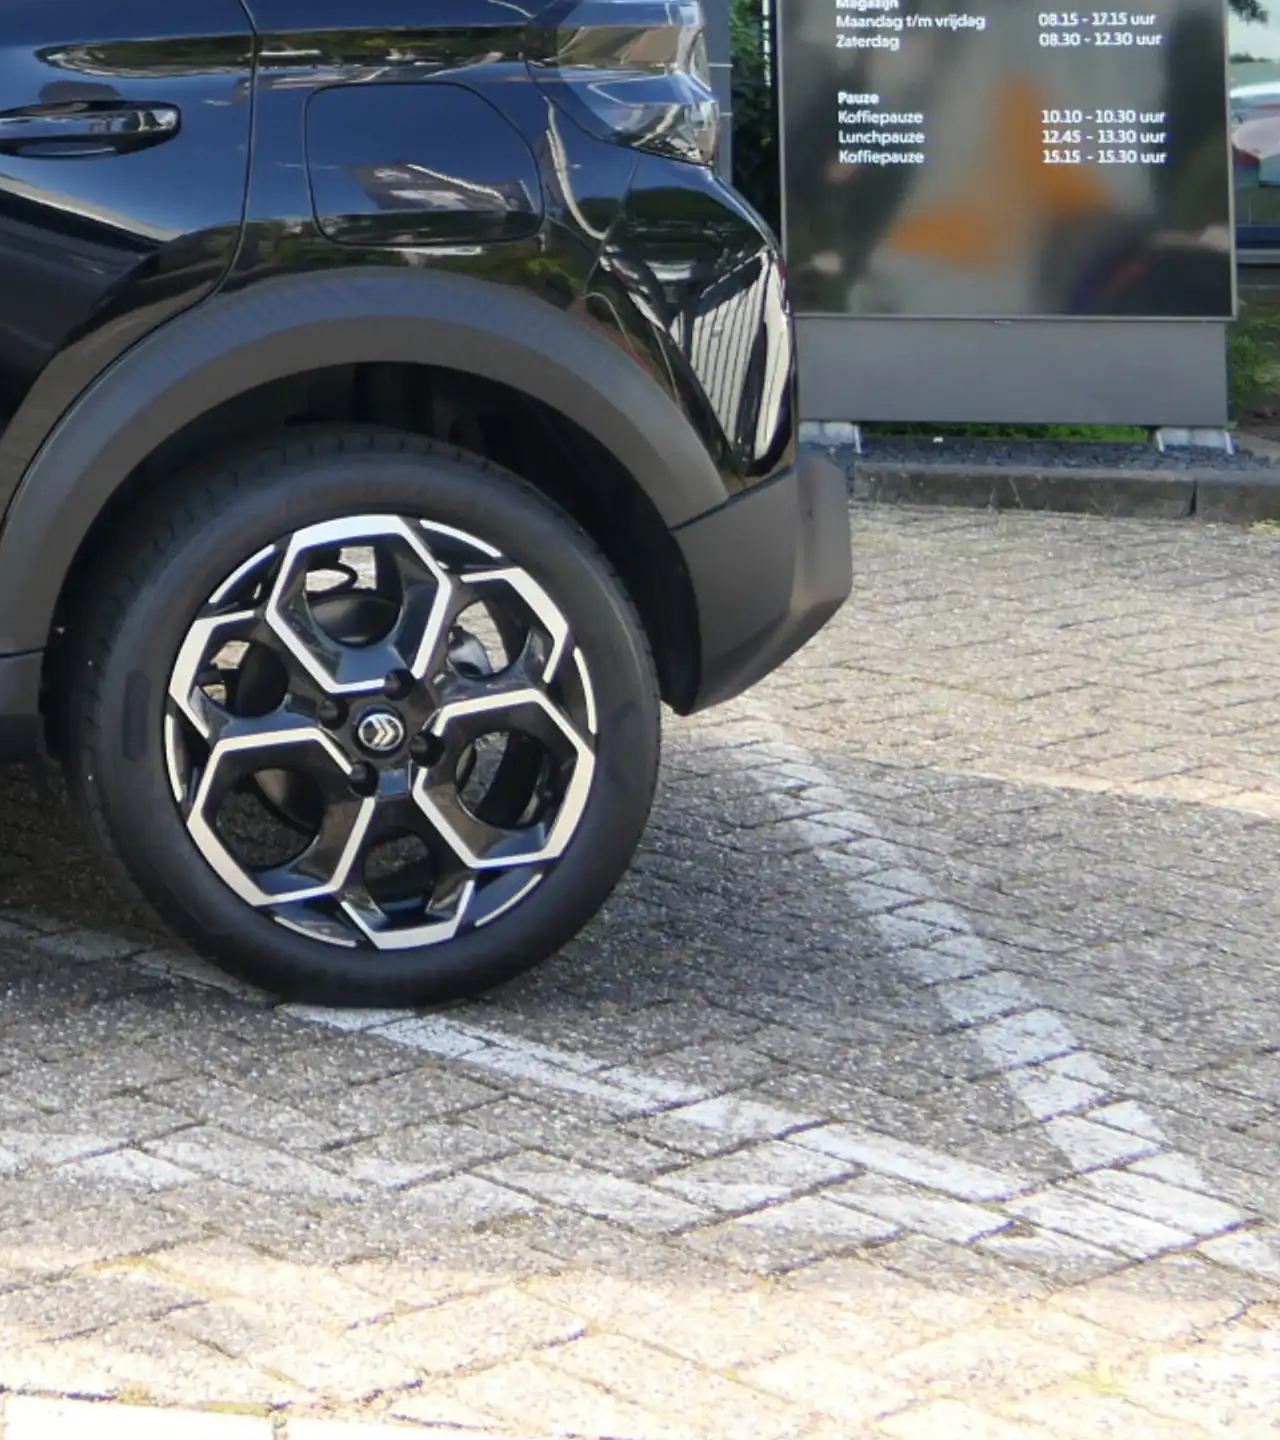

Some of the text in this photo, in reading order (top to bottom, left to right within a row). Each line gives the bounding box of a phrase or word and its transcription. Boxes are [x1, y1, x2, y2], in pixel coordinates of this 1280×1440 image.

[835, 15, 903, 31] Maandag
[905, 14, 932, 28] t/m
[935, 13, 986, 31] vrijdag
[1130, 13, 1156, 25] uur
[836, 34, 900, 51] Zaterdag
[1136, 34, 1162, 46] uur
[837, 91, 880, 104] Pauze
[838, 110, 924, 127] Koffiepauze
[1041, 109, 1083, 124] 10.10
[1095, 109, 1137, 124] 10.30
[1139, 111, 1166, 124] uur
[838, 130, 925, 147] Lunchpauze
[1042, 129, 1081, 144] 12.45
[1097, 129, 1137, 144] 13.30
[1140, 131, 1167, 144] uur
[839, 150, 925, 166] Koffiepauze
[1140, 151, 1167, 164] uur
